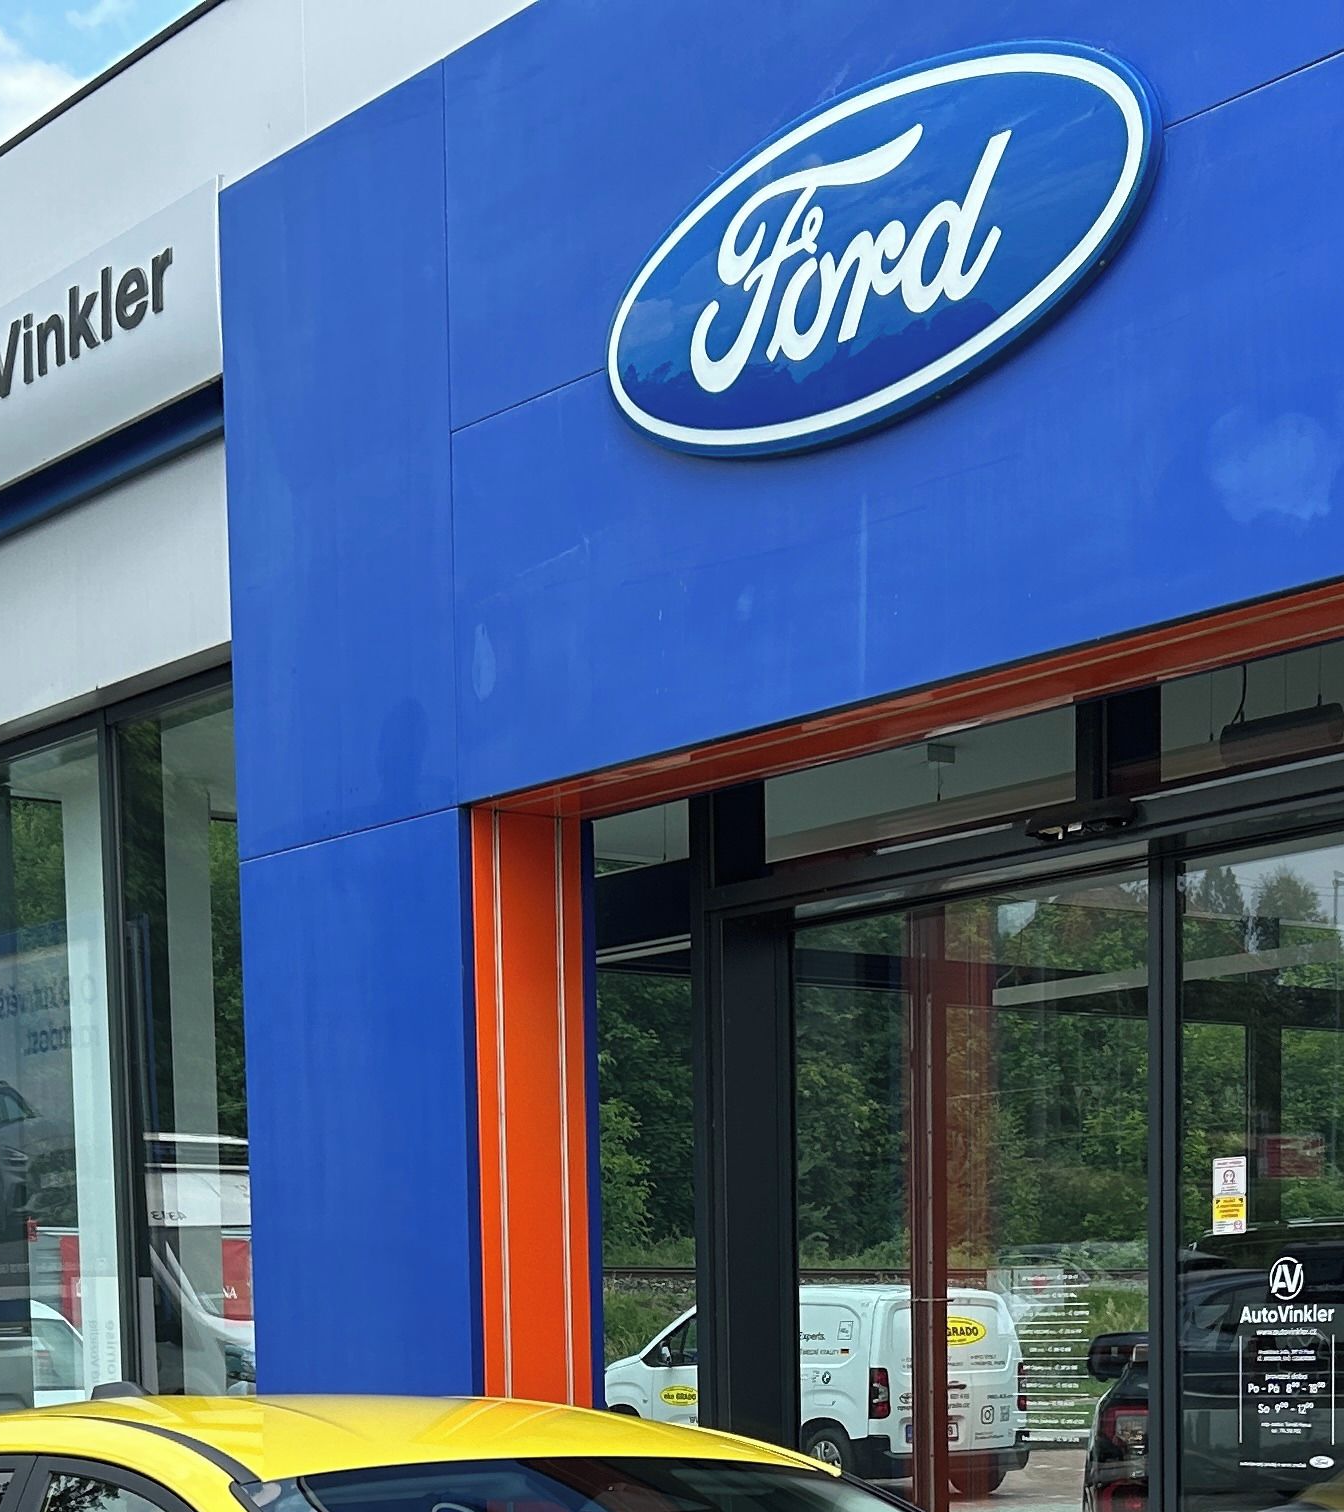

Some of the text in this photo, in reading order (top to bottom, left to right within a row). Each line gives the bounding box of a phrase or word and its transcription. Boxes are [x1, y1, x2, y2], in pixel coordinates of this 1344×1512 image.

[690, 123, 1012, 393] Ford
[1240, 1304, 1335, 1323] AutoVinkler
[1247, 1383, 1260, 1394] Po
[1257, 1403, 1271, 1414] So
